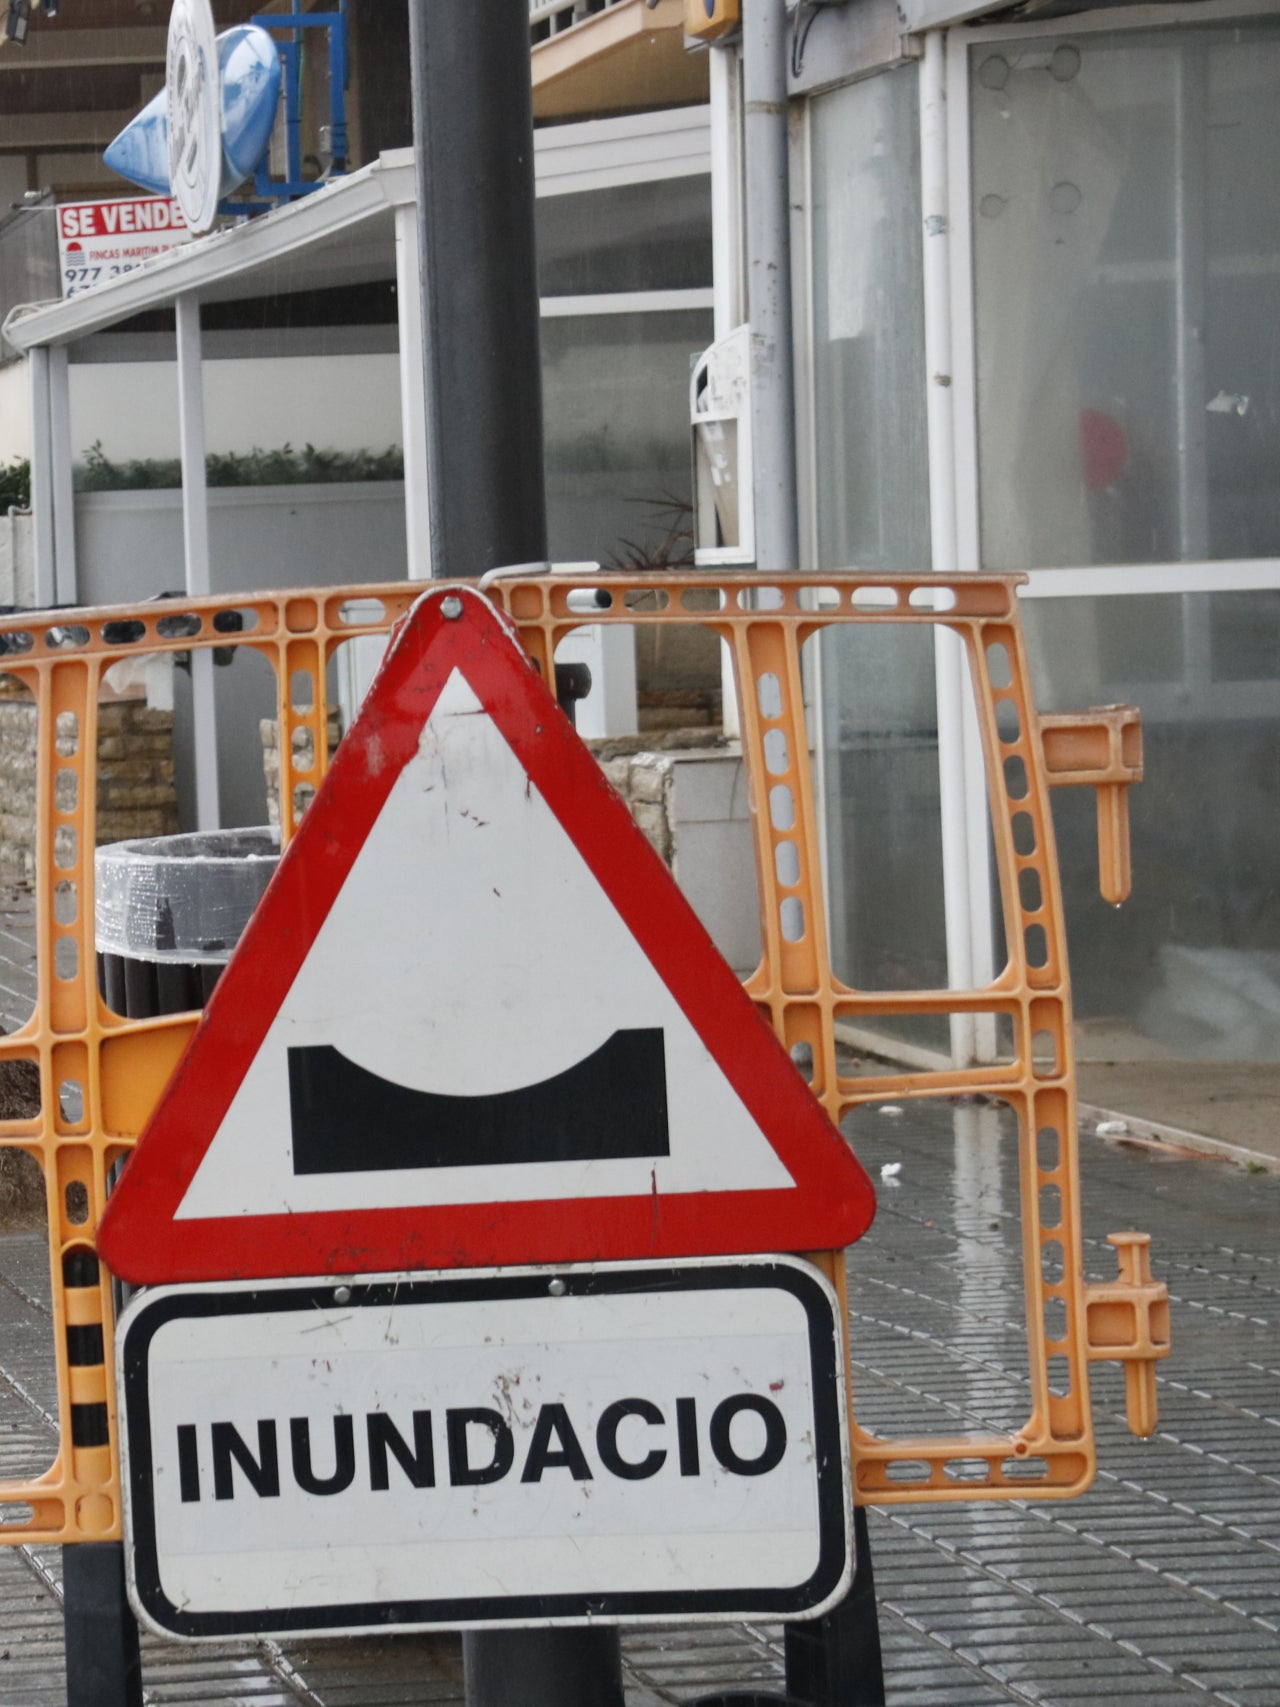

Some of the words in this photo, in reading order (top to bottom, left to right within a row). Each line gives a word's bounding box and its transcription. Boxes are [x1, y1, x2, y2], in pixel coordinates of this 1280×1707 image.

[62, 208, 96, 237] SE
[100, 201, 185, 233] VENDE
[89, 249, 119, 260] FINCAS
[65, 267, 102, 282] 977
[177, 1393, 787, 1502] INUNDACIO
